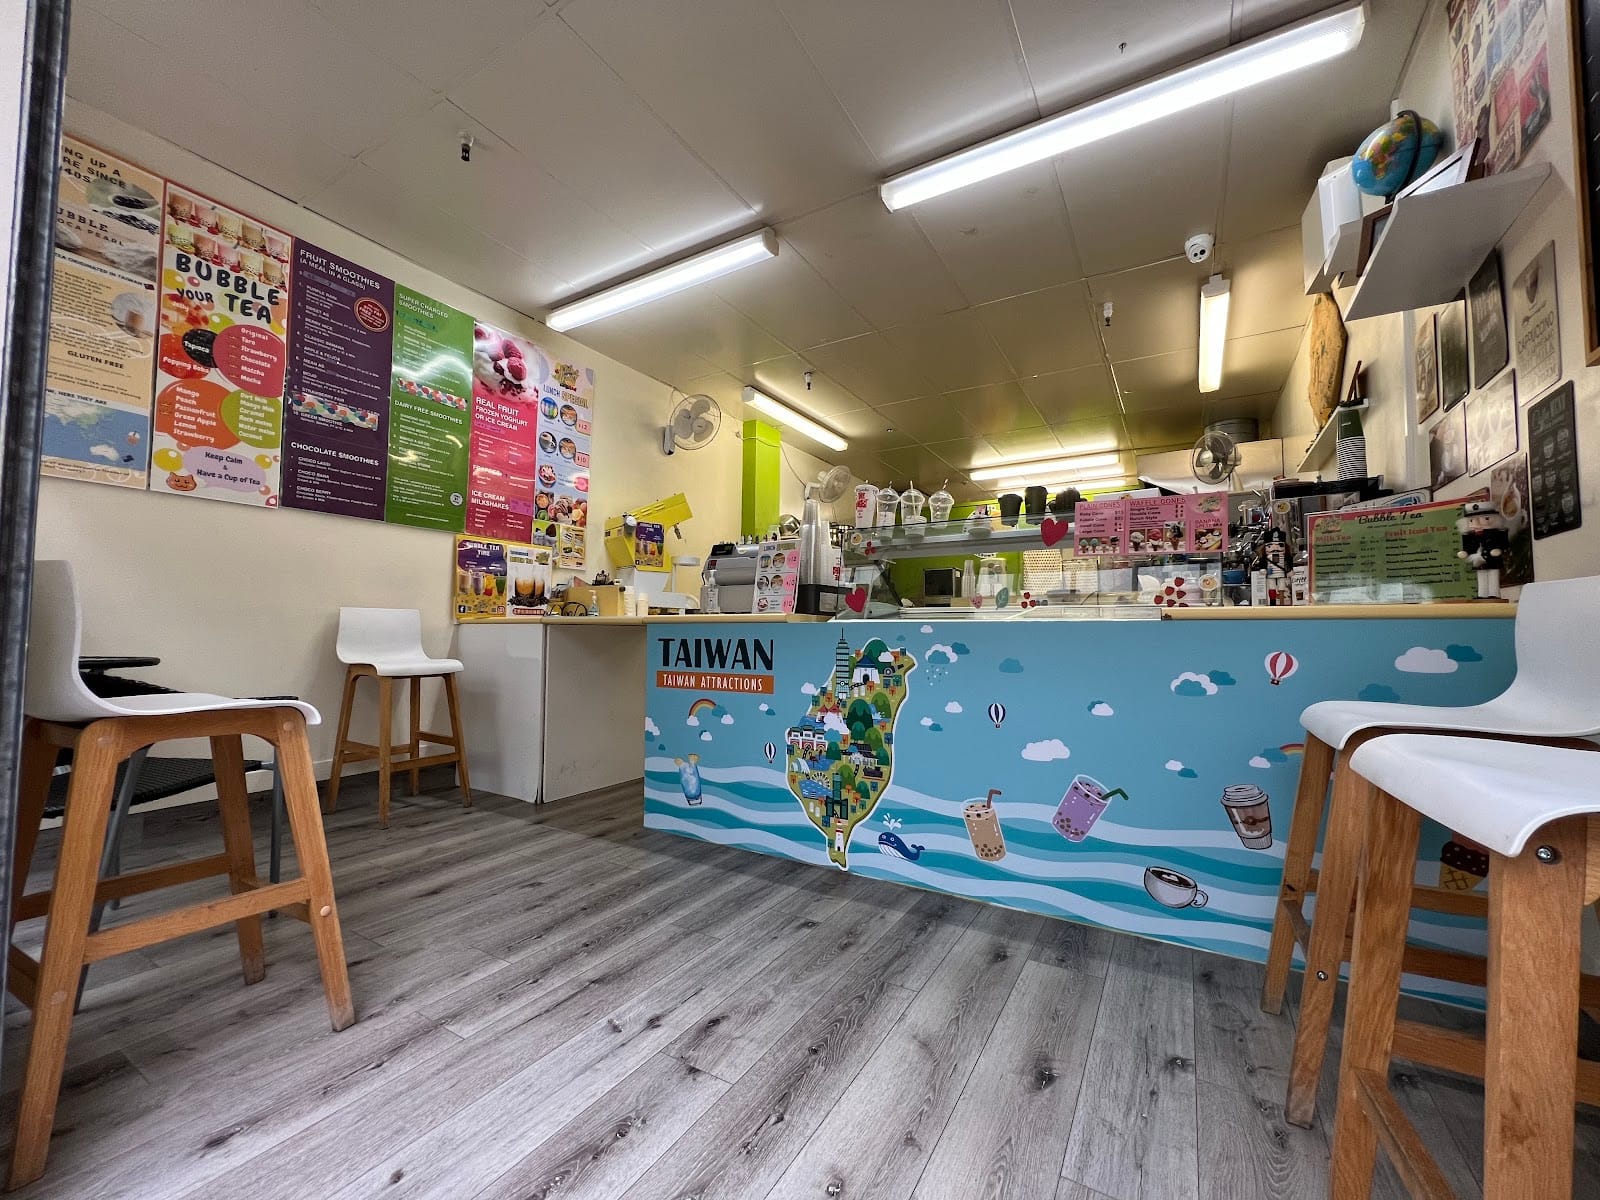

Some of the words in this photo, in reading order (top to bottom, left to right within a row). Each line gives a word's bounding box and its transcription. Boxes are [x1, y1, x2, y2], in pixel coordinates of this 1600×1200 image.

[59, 166, 92, 184] 40S
[90, 157, 107, 170] UP
[112, 168, 122, 177] A
[87, 166, 128, 189] SINCE
[87, 230, 124, 247] PEARL
[300, 249, 328, 266] FRUIT
[328, 262, 381, 290] SMOOTHIES
[308, 260, 327, 273] MEAL
[118, 274, 143, 286] TAIWAN
[176, 253, 280, 306] BUBBLE
[176, 287, 214, 304] YOUR
[224, 293, 272, 324] TEA
[398, 293, 420, 306] SUPER
[420, 302, 449, 318] CHARGED
[398, 299, 434, 319] SMOOTHIES
[240, 327, 268, 342] Original
[240, 336, 256, 346] Taro
[184, 341, 210, 353] Tapioca
[240, 345, 278, 362] Strawberry
[67, 350, 102, 364] GLUTEN
[104, 358, 124, 370] FREE
[162, 356, 192, 370] Popping
[240, 354, 271, 368] Chocolate
[240, 365, 265, 377] Matcha
[240, 374, 262, 385] Mocha
[176, 386, 200, 398] Mango
[175, 395, 197, 406] Peach
[475, 396, 496, 410] REAL
[497, 402, 520, 417] FRUIT
[174, 402, 216, 418] Passionfruit
[394, 400, 413, 410] DAIRY
[413, 406, 430, 415] FREE
[430, 410, 463, 424] SMOOTHIES
[475, 406, 500, 418] FROZEN
[500, 412, 528, 427] YOGHURT
[173, 420, 197, 431] Lemon
[174, 411, 196, 422] Green
[196, 416, 217, 427] Apple
[474, 413, 485, 421] OR
[485, 416, 496, 424] ICE
[496, 420, 518, 432] CREAM
[172, 428, 215, 444] Strawberry
[204, 452, 224, 462] Keep
[225, 455, 244, 465] Calm
[290, 442, 337, 457] CHOCOLATE
[338, 452, 380, 466] SMOOTHIES
[196, 468, 217, 479] Have
[224, 473, 239, 483] Cup
[248, 478, 261, 486] Tea
[471, 490, 482, 498] ICE
[482, 491, 506, 502] CREAM
[471, 498, 510, 510] MILKSHAKES
[1358, 512, 1398, 525] Bubble
[1400, 512, 1424, 520] Tea
[658, 638, 774, 670] TAIWAN
[663, 674, 696, 687] TAIWAN
[700, 676, 763, 691] ATTRACTIONS
